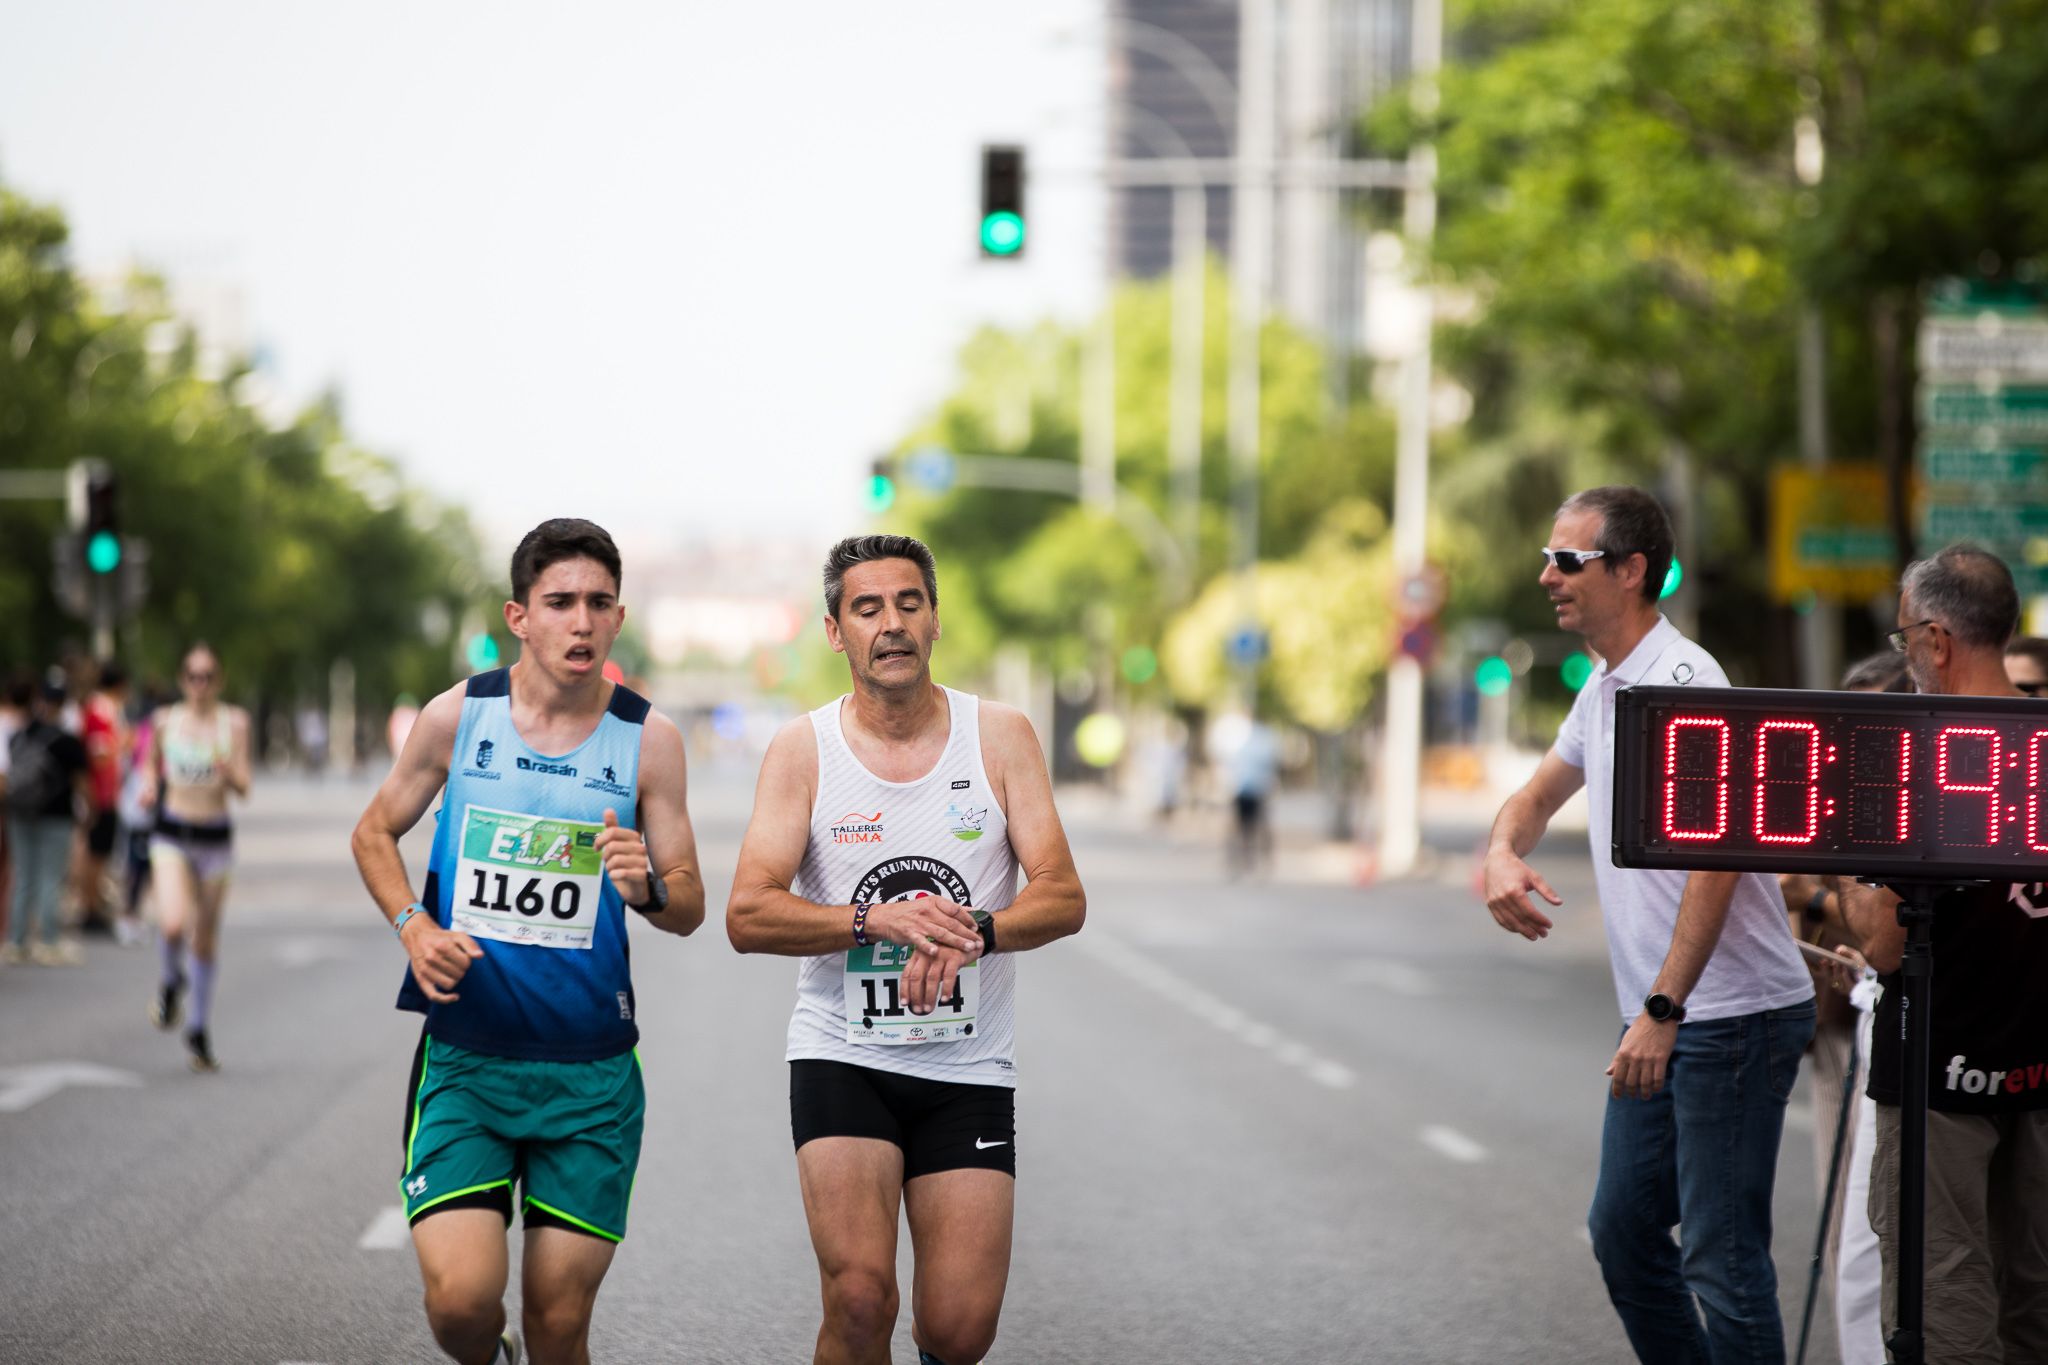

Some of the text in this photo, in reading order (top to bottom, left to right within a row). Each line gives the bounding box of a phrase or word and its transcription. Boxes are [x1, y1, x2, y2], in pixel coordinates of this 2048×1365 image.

[488, 826, 572, 868] ELA
[831, 824, 884, 837] TALLERES
[834, 833, 881, 843] JUMA
[469, 868, 580, 920] 1160
[877, 859, 950, 880] RUNNING
[947, 875, 969, 907] TEA
[861, 975, 964, 1016] 114
[1945, 1055, 2048, 1096] forev
